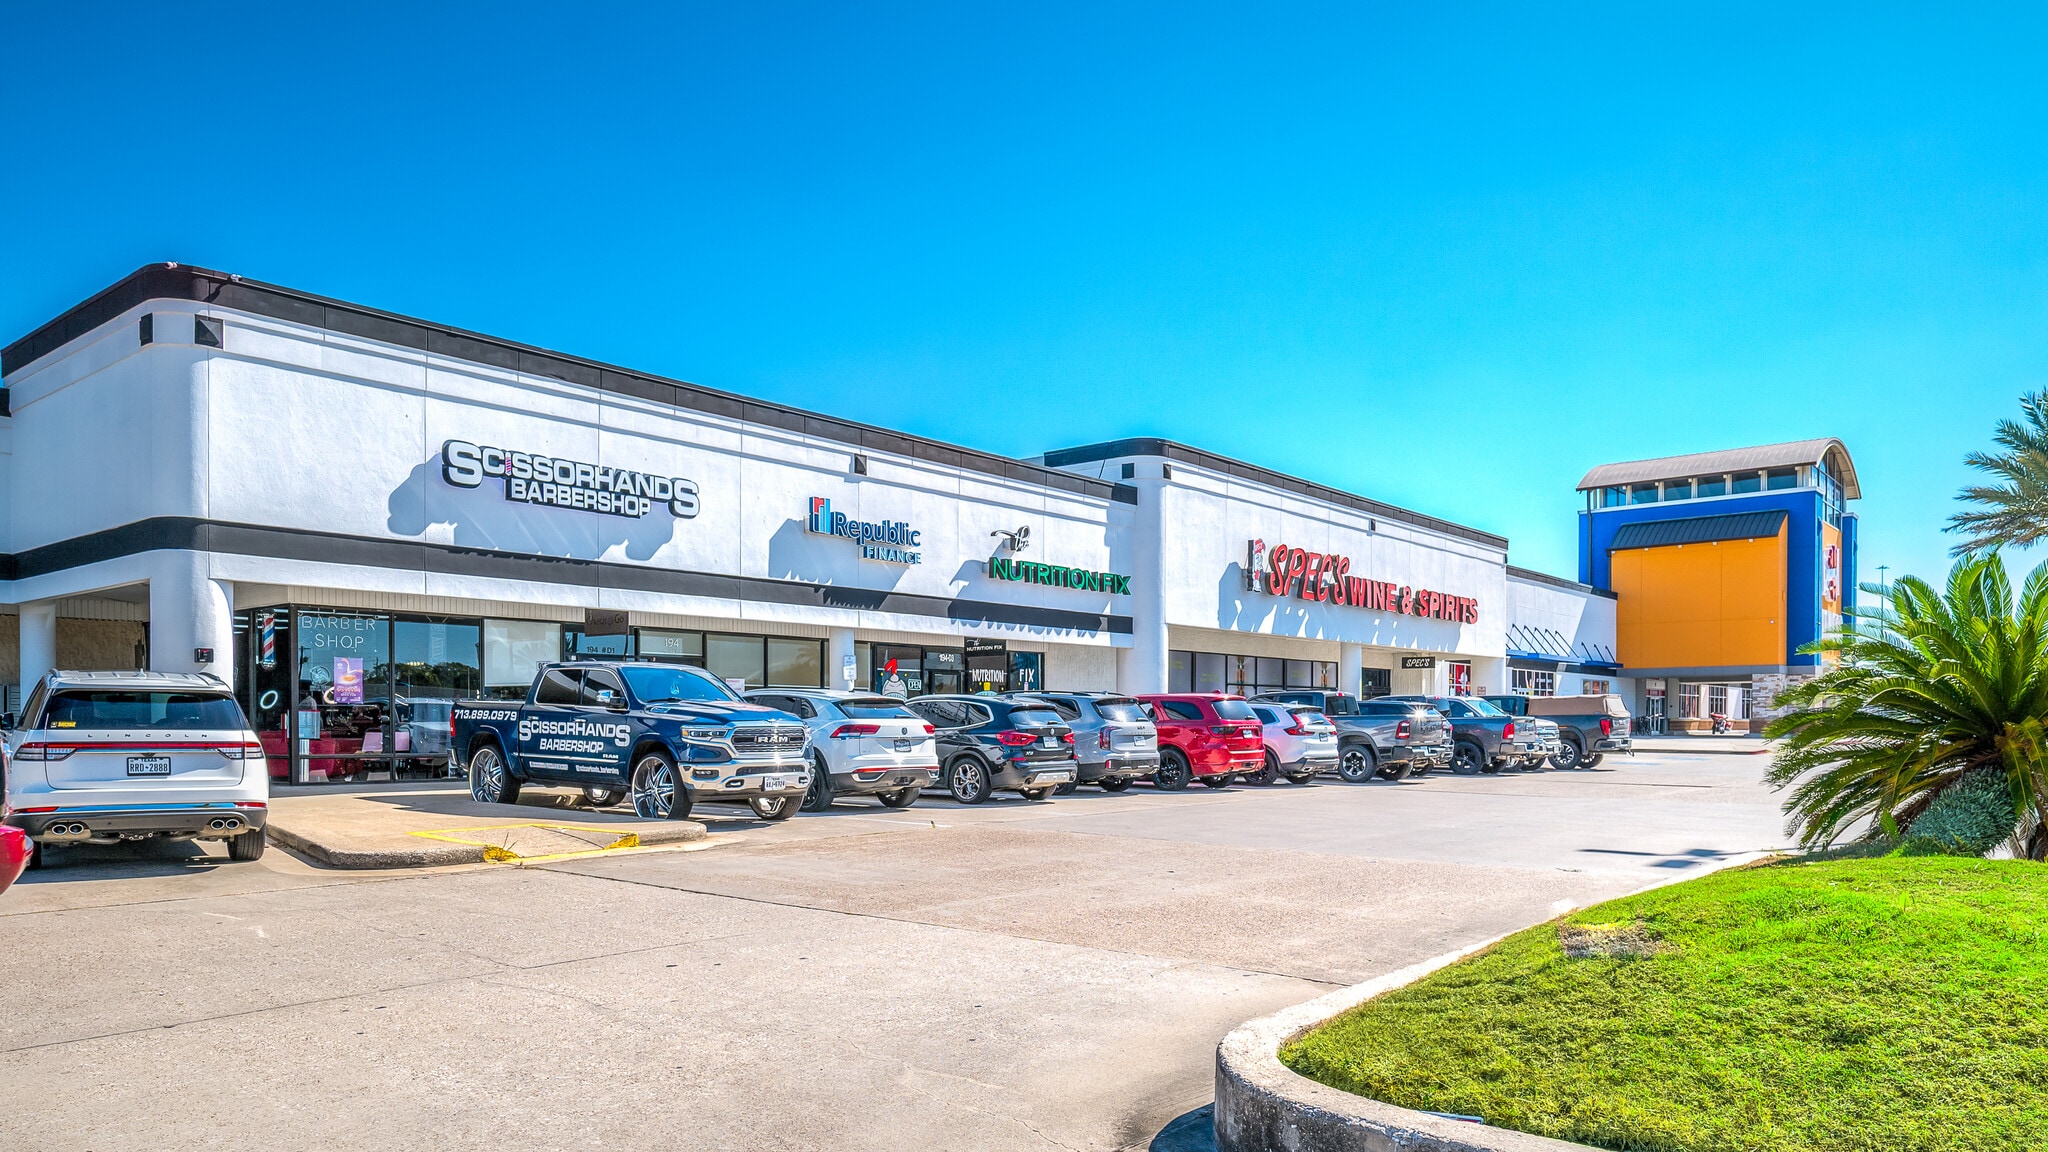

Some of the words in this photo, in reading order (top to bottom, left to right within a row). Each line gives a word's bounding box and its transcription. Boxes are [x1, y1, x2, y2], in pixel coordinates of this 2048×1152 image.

[443, 440, 699, 518] SCISSORHANDS
[508, 478, 651, 517] BARBERSHOP
[831, 511, 921, 547] Republic
[864, 545, 921, 564] FINANCE
[989, 557, 1099, 592] NUTRITION
[1099, 572, 1132, 596] FIX
[1267, 543, 1350, 606] SPEC'S
[1347, 576, 1397, 612] WINE
[1400, 586, 1414, 616] &
[1414, 588, 1478, 625] SPIRITS
[301, 616, 376, 631] BARBER
[314, 633, 364, 649] SHOP
[664, 638, 679, 649] 194
[972, 668, 1004, 683] NUTRITION
[1019, 668, 1035, 682] FIX
[454, 709, 518, 721] 713.899.0979
[519, 720, 631, 748] SCISSORHANDS
[539, 738, 604, 753] BARBERSHOP
